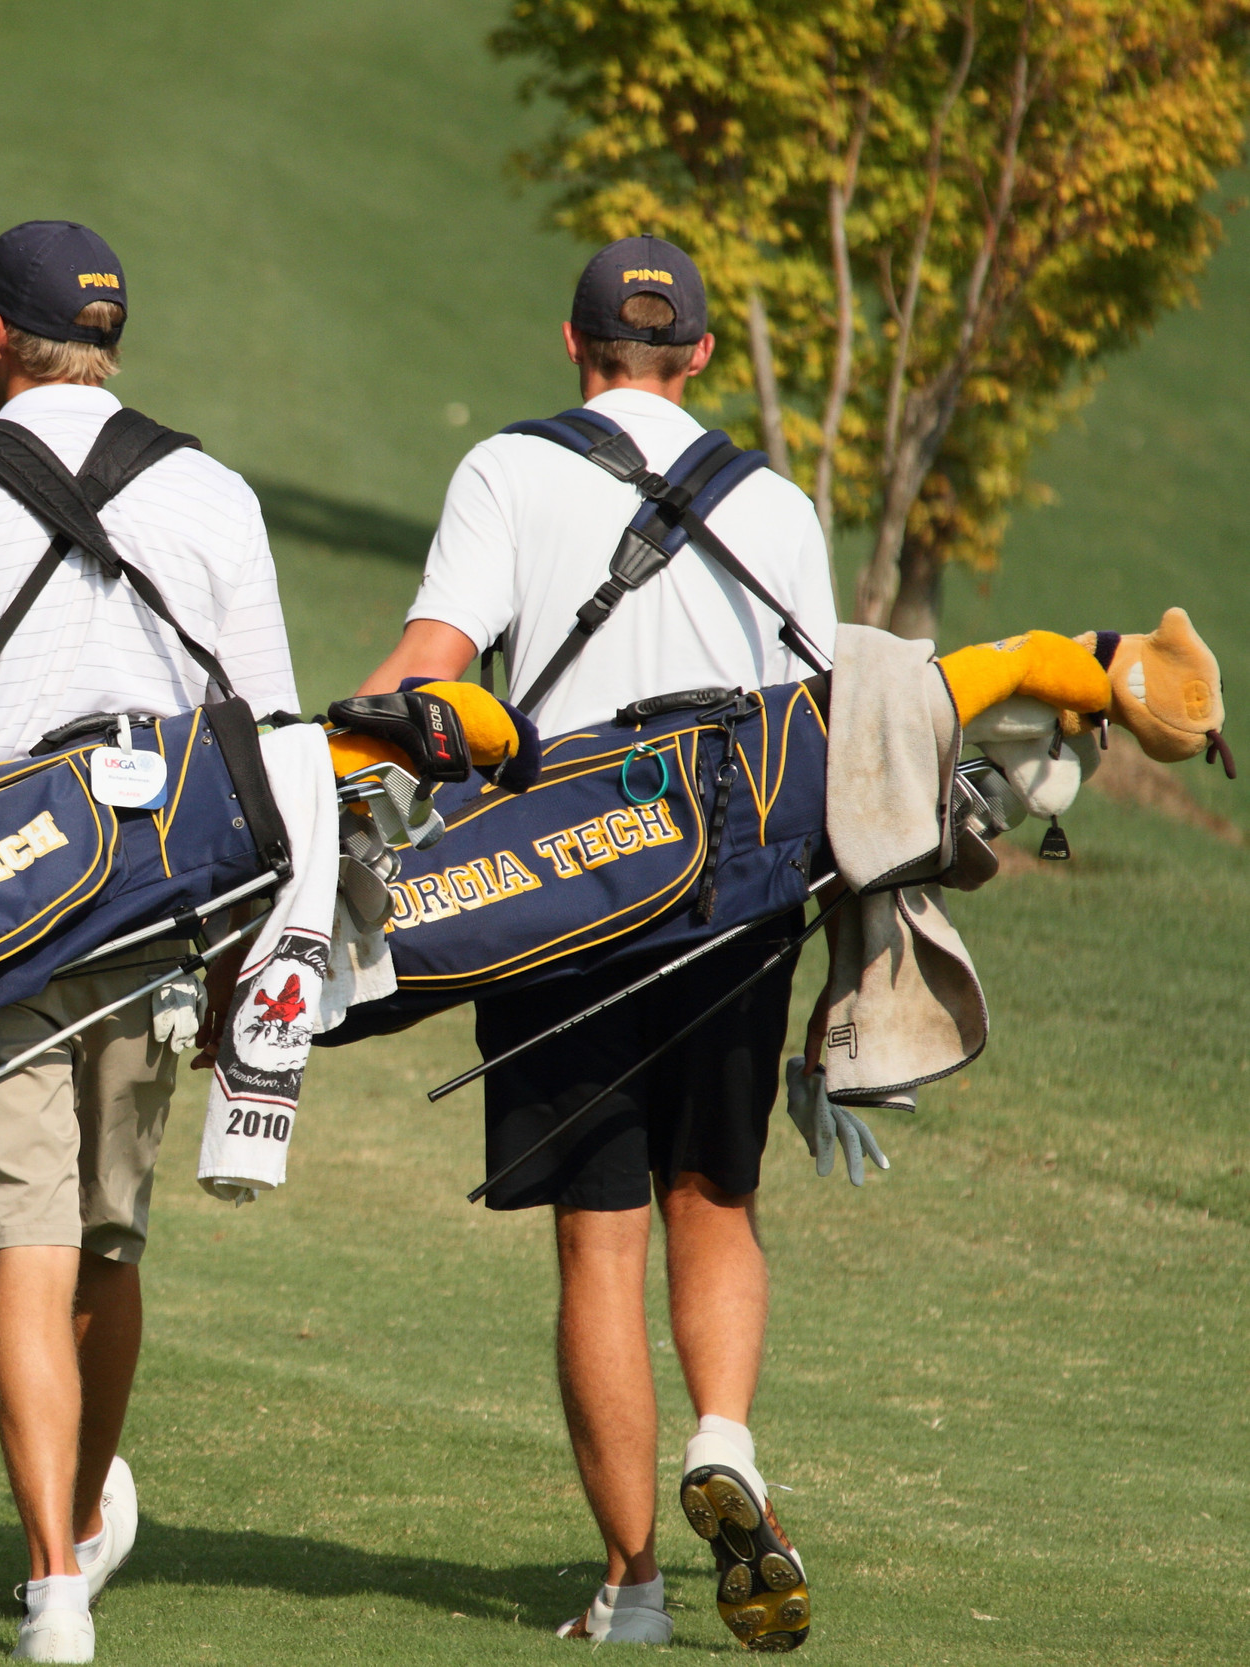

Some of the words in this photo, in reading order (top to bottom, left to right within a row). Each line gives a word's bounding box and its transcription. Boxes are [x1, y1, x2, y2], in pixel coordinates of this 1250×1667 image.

[78, 272, 120, 289] PING
[623, 268, 673, 285] PING
[104, 758, 136, 770] USGA
[1043, 850, 1067, 858] PING
[375, 850, 543, 934] ORGIA
[533, 797, 684, 879] TECH
[226, 1108, 290, 1142] 2010
